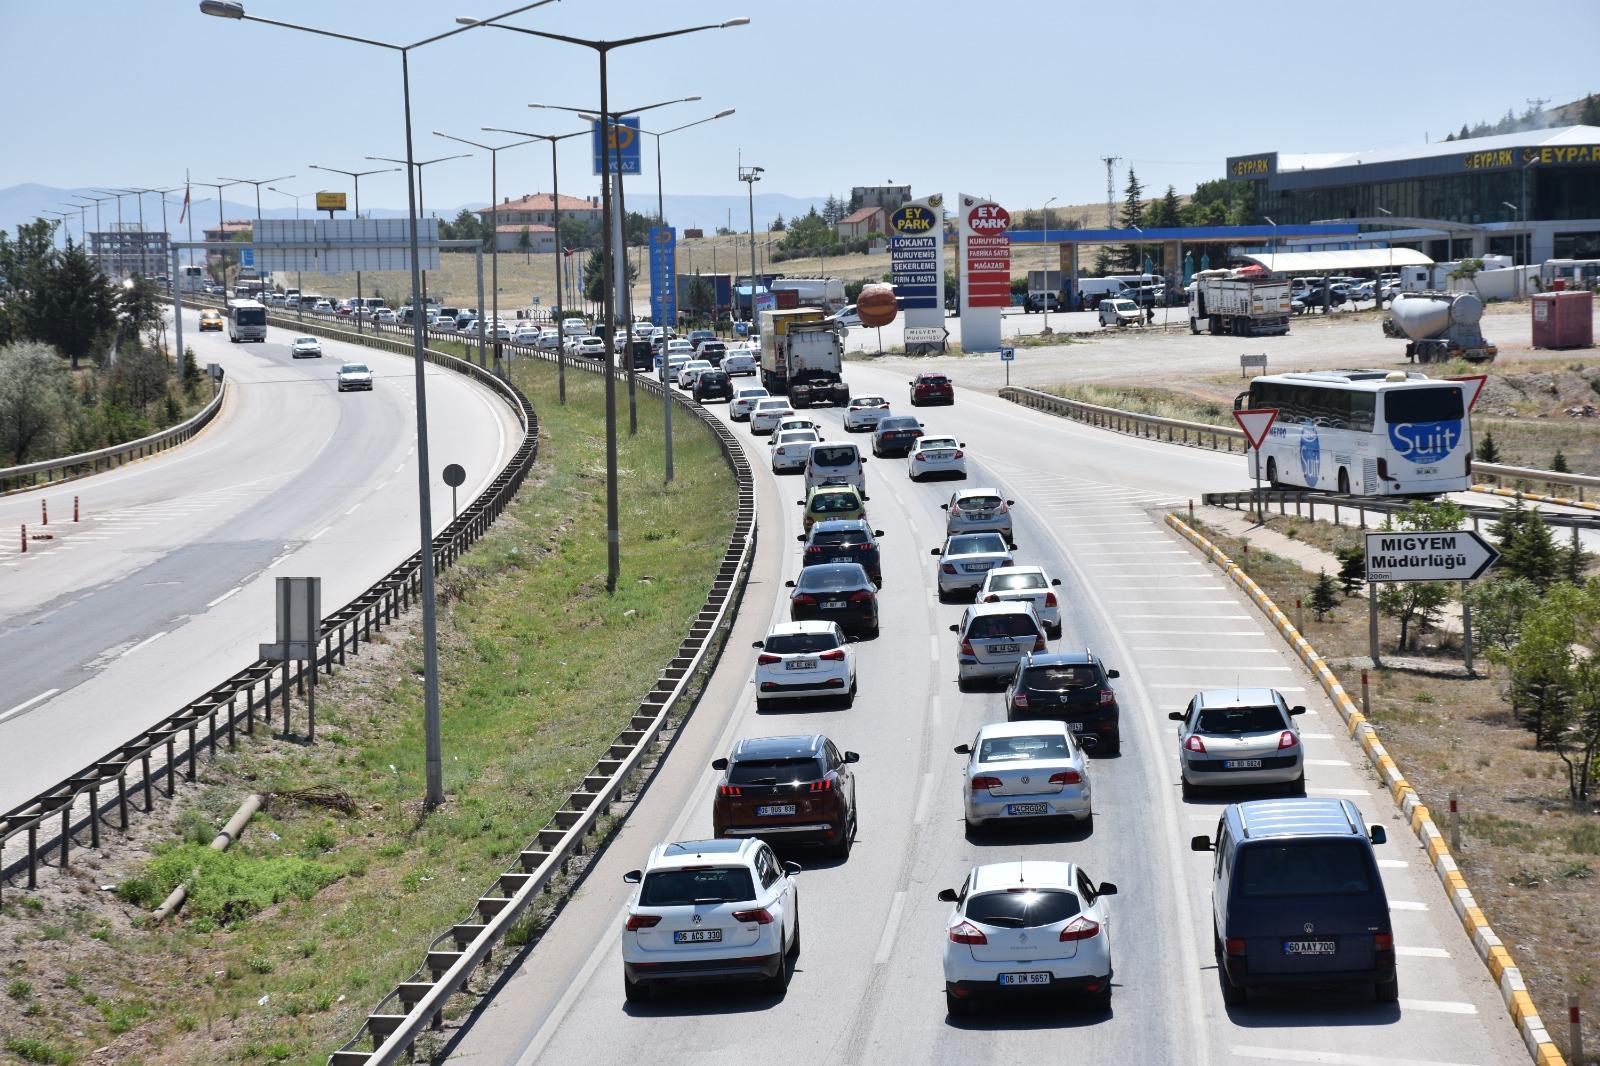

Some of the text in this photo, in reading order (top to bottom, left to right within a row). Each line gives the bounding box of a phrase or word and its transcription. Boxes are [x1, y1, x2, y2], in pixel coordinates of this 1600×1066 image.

[1474, 150, 1512, 168] EYPARK
[1238, 160, 1268, 175] EYPARK
[905, 207, 922, 218] EY
[978, 207, 1000, 218] EY
[897, 219, 930, 230] PARK
[972, 219, 1006, 229] PARK
[894, 238, 934, 247] LOKANTA
[969, 237, 1009, 246] KURUYEMİŞ
[893, 249, 935, 259] KURUYEMİŞ
[893, 262, 935, 271] ŞEKERLEME
[917, 275, 935, 283] PASTA
[1394, 422, 1456, 456] Suit
[1302, 446, 1319, 478] Suit
[1381, 536, 1457, 551] MIGYEM
[1371, 553, 1467, 570] Müdürlüğü
[679, 931, 720, 940] 06 ACS 330
[1289, 943, 1300, 952] 60
[1301, 942, 1317, 951] AAY
[1319, 942, 1335, 951] 700
[1005, 975, 1014, 983] 06
